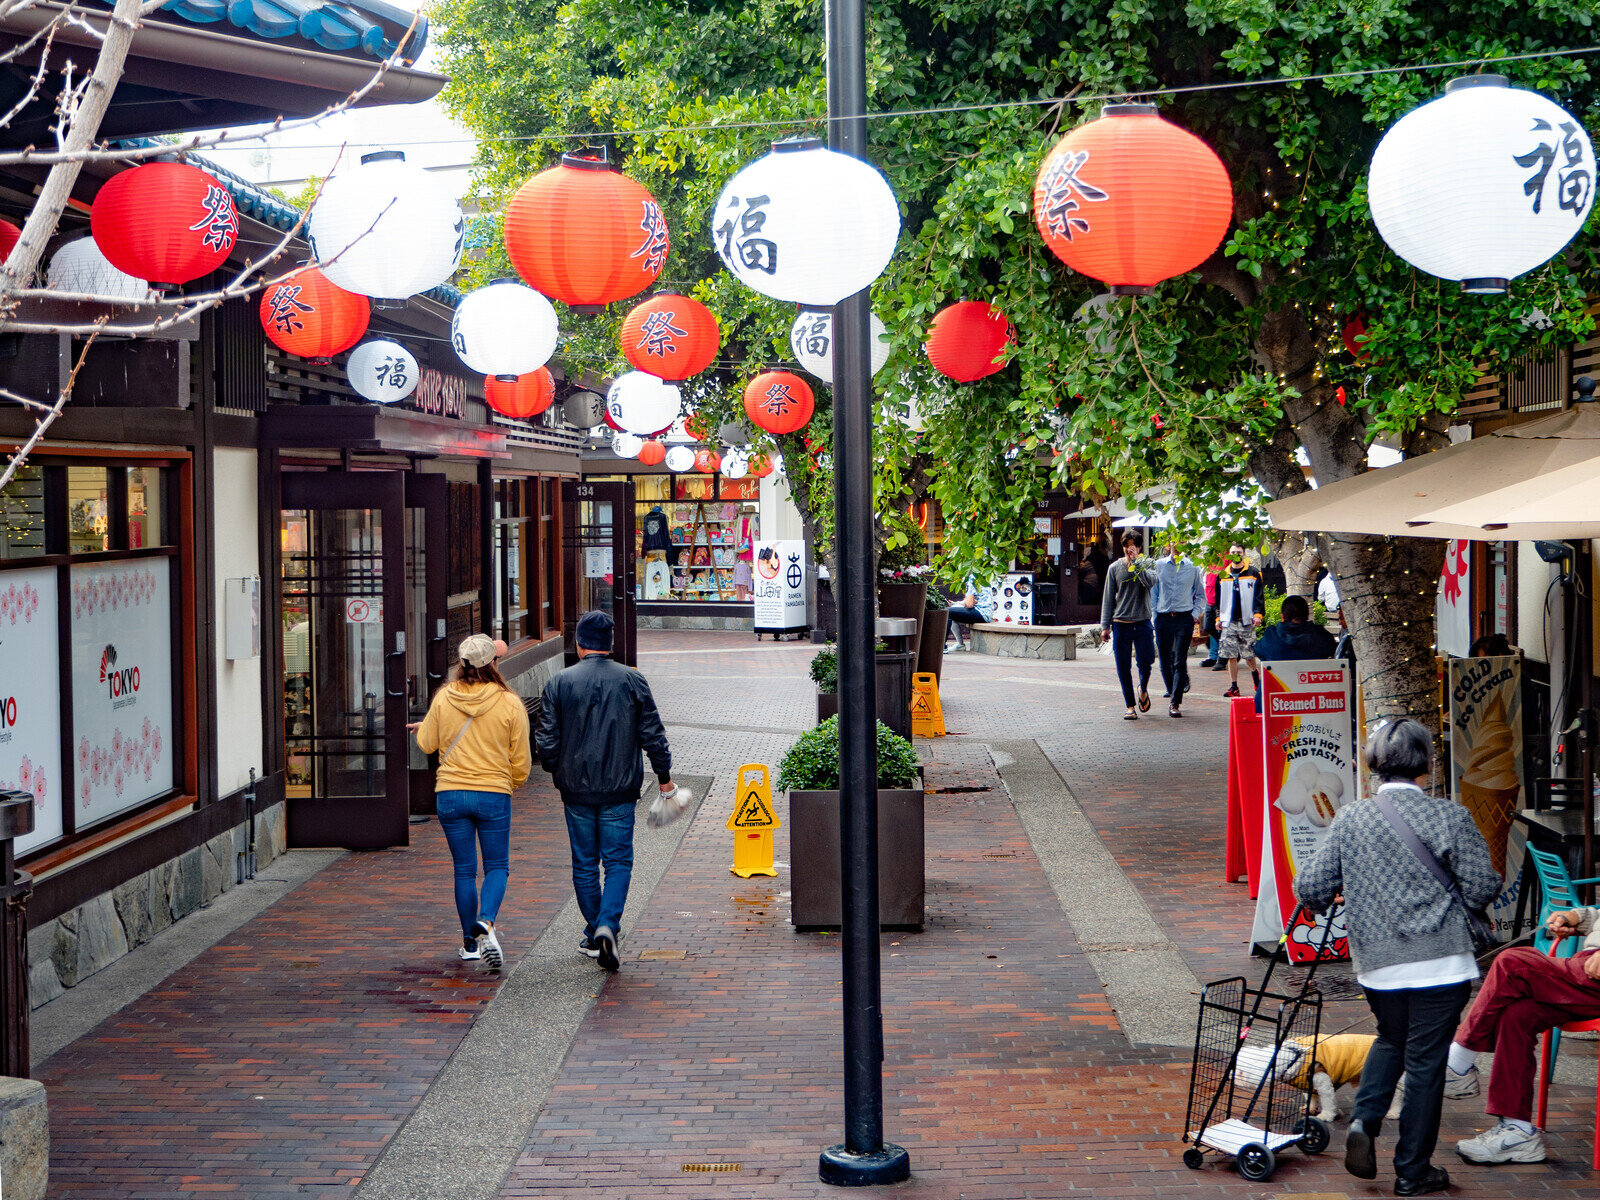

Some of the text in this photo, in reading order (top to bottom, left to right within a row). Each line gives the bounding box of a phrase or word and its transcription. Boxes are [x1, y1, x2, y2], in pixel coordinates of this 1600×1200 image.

[1512, 118, 1590, 217] 福
[1038, 151, 1109, 243] 祭
[189, 184, 239, 253] 祭
[715, 195, 778, 275] 福
[268, 285, 316, 335] 祭
[636, 311, 689, 358] 祭
[795, 315, 830, 357] 福
[374, 355, 407, 389] 福
[759, 384, 799, 416] 祭
[577, 486, 594, 496] 134
[1037, 500, 1049, 508] 137
[108, 666, 140, 699] TOKYO
[1309, 673, 1341, 681] ヤマザキ
[1454, 659, 1491, 702] COLD
[1272, 695, 1344, 711] Steamed Buns
[1455, 668, 1513, 730] Ice Cream
[1282, 737, 1341, 752] FRESH HOT
[1286, 748, 1346, 770] AND TASTY!
[736, 798, 750, 818] CAUTION
[756, 798, 770, 817] CUIDADO
